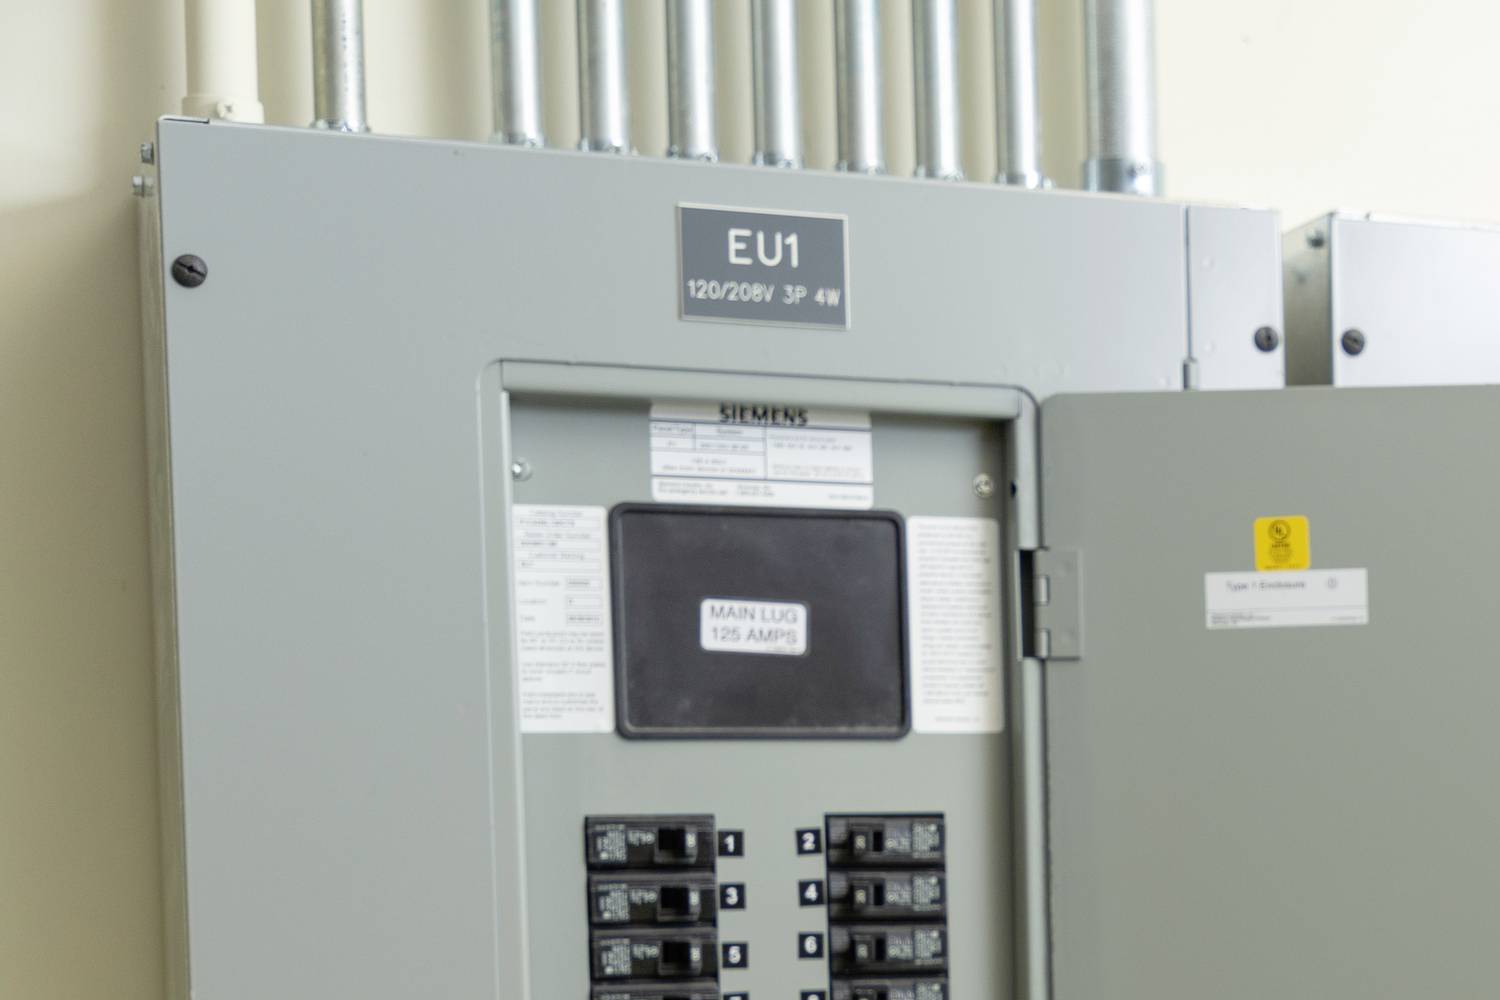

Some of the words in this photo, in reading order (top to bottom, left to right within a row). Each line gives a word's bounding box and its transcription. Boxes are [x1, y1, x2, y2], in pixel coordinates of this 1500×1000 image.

[727, 228, 800, 269] EU1
[687, 278, 775, 304] 120/208V
[782, 284, 808, 305] 3P
[814, 287, 841, 307] 4W
[719, 402, 809, 427] SIEMENS
[710, 604, 756, 620] MAIN
[760, 607, 798, 624] LUG
[711, 625, 741, 642] 125
[746, 627, 798, 645] AMPS
[724, 835, 734, 852] 1
[802, 832, 815, 850] 2
[726, 887, 738, 905] 3
[805, 883, 818, 901] 4
[804, 936, 817, 954] 6
[729, 946, 741, 963] 5
